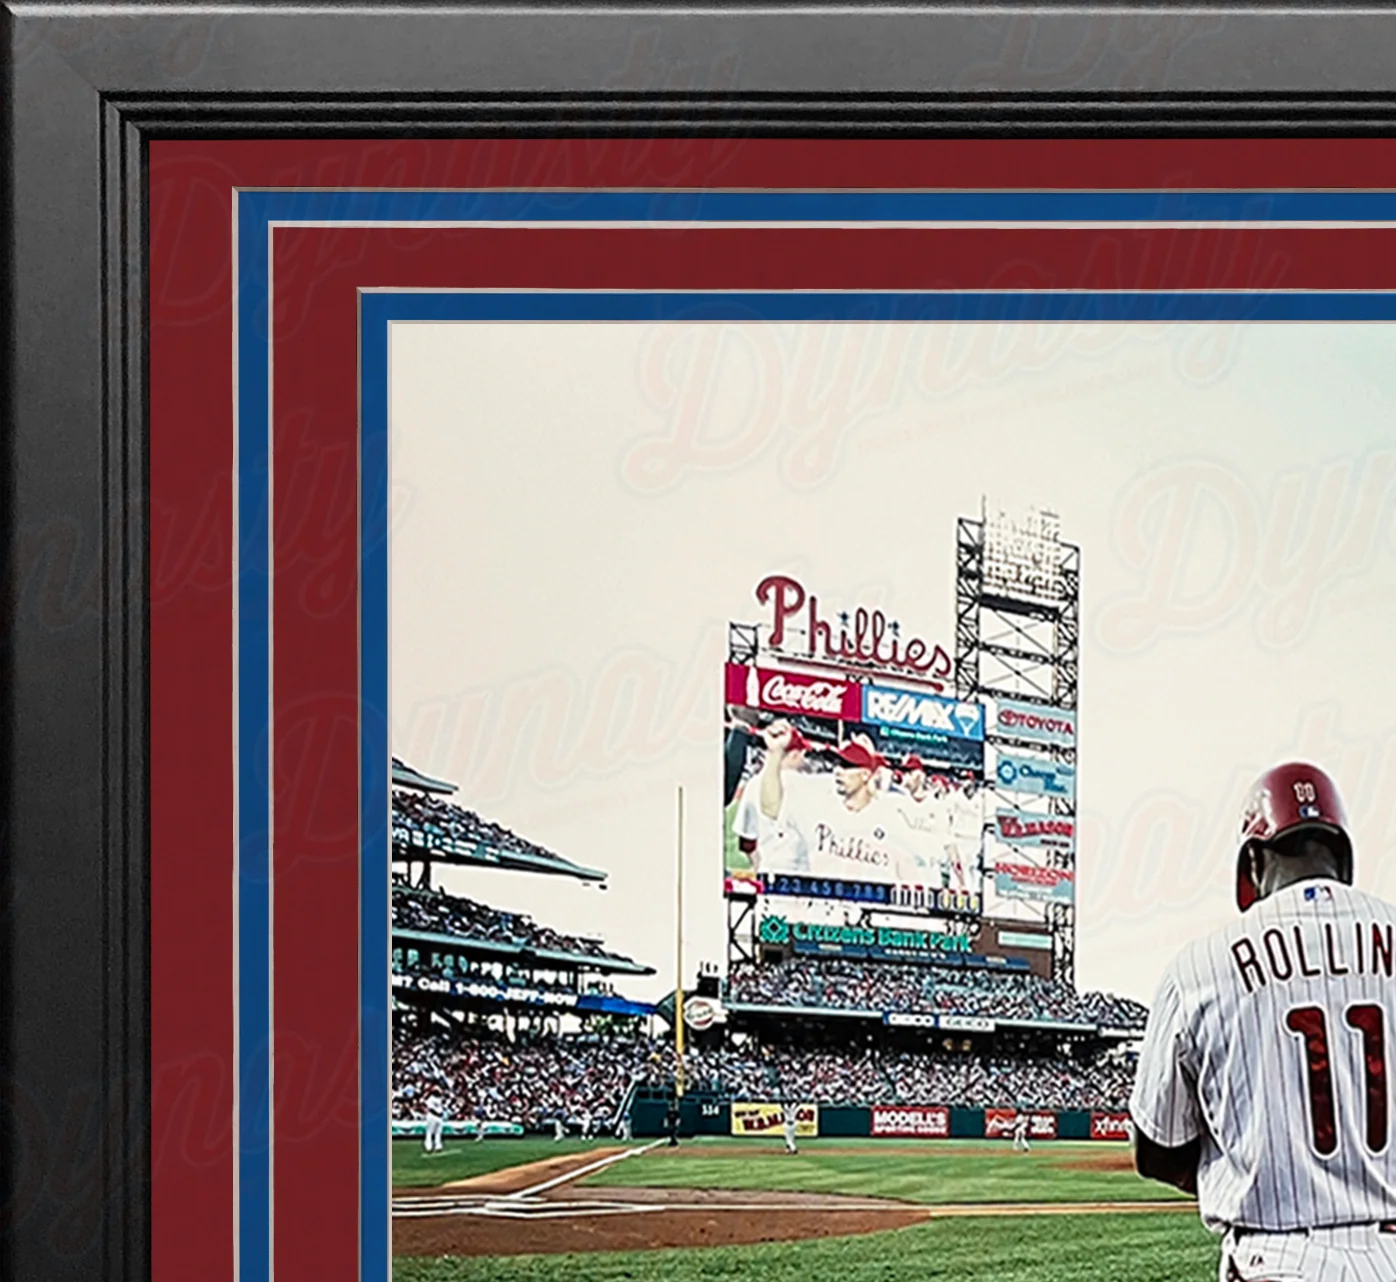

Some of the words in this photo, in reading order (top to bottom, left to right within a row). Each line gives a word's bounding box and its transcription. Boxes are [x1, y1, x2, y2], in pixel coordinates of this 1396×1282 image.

[756, 575, 953, 680] Phillies
[868, 690, 956, 731] RE/MAX
[1017, 713, 1074, 736] TOYOTA
[793, 921, 875, 943] Citizens
[878, 929, 926, 948] Bank
[929, 934, 972, 952] Park
[1285, 1004, 1388, 1157] 11
[873, 1110, 946, 1126] MODELL'S
